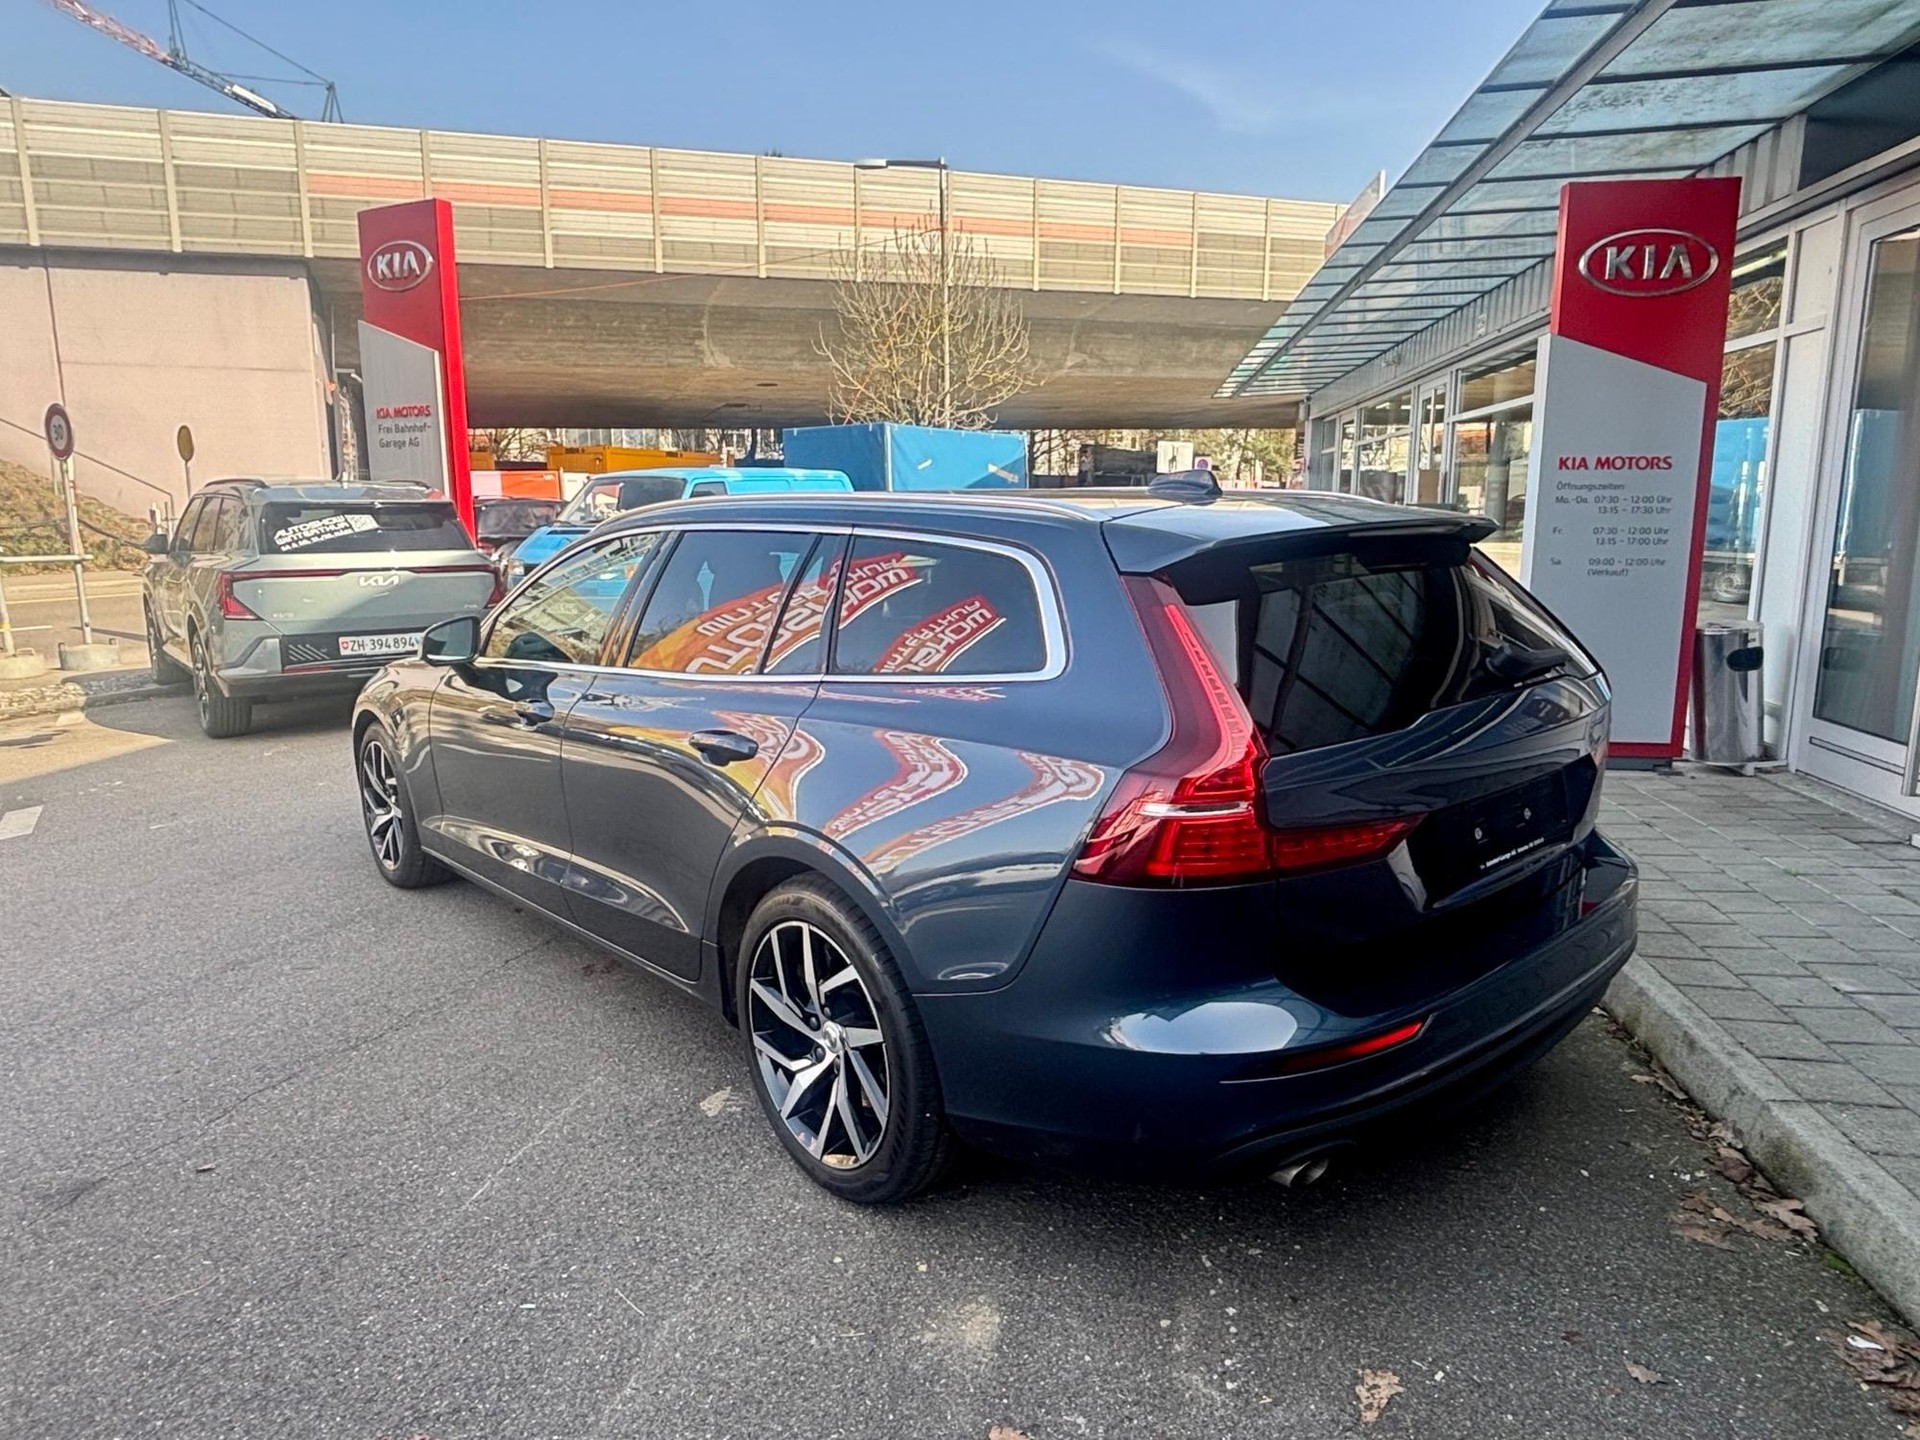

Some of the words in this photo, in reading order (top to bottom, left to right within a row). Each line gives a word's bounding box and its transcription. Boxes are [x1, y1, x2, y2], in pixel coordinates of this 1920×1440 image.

[376, 251, 420, 279] KIA
[1604, 244, 1693, 280] KIA
[376, 407, 391, 419] KIA
[393, 405, 431, 418] MOTORS
[53, 423, 64, 441] 30
[379, 438, 407, 449] Garage
[408, 437, 420, 447] AG
[1558, 456, 1588, 470] KIA
[1594, 455, 1673, 471] MOTORS
[360, 574, 399, 587] KIA
